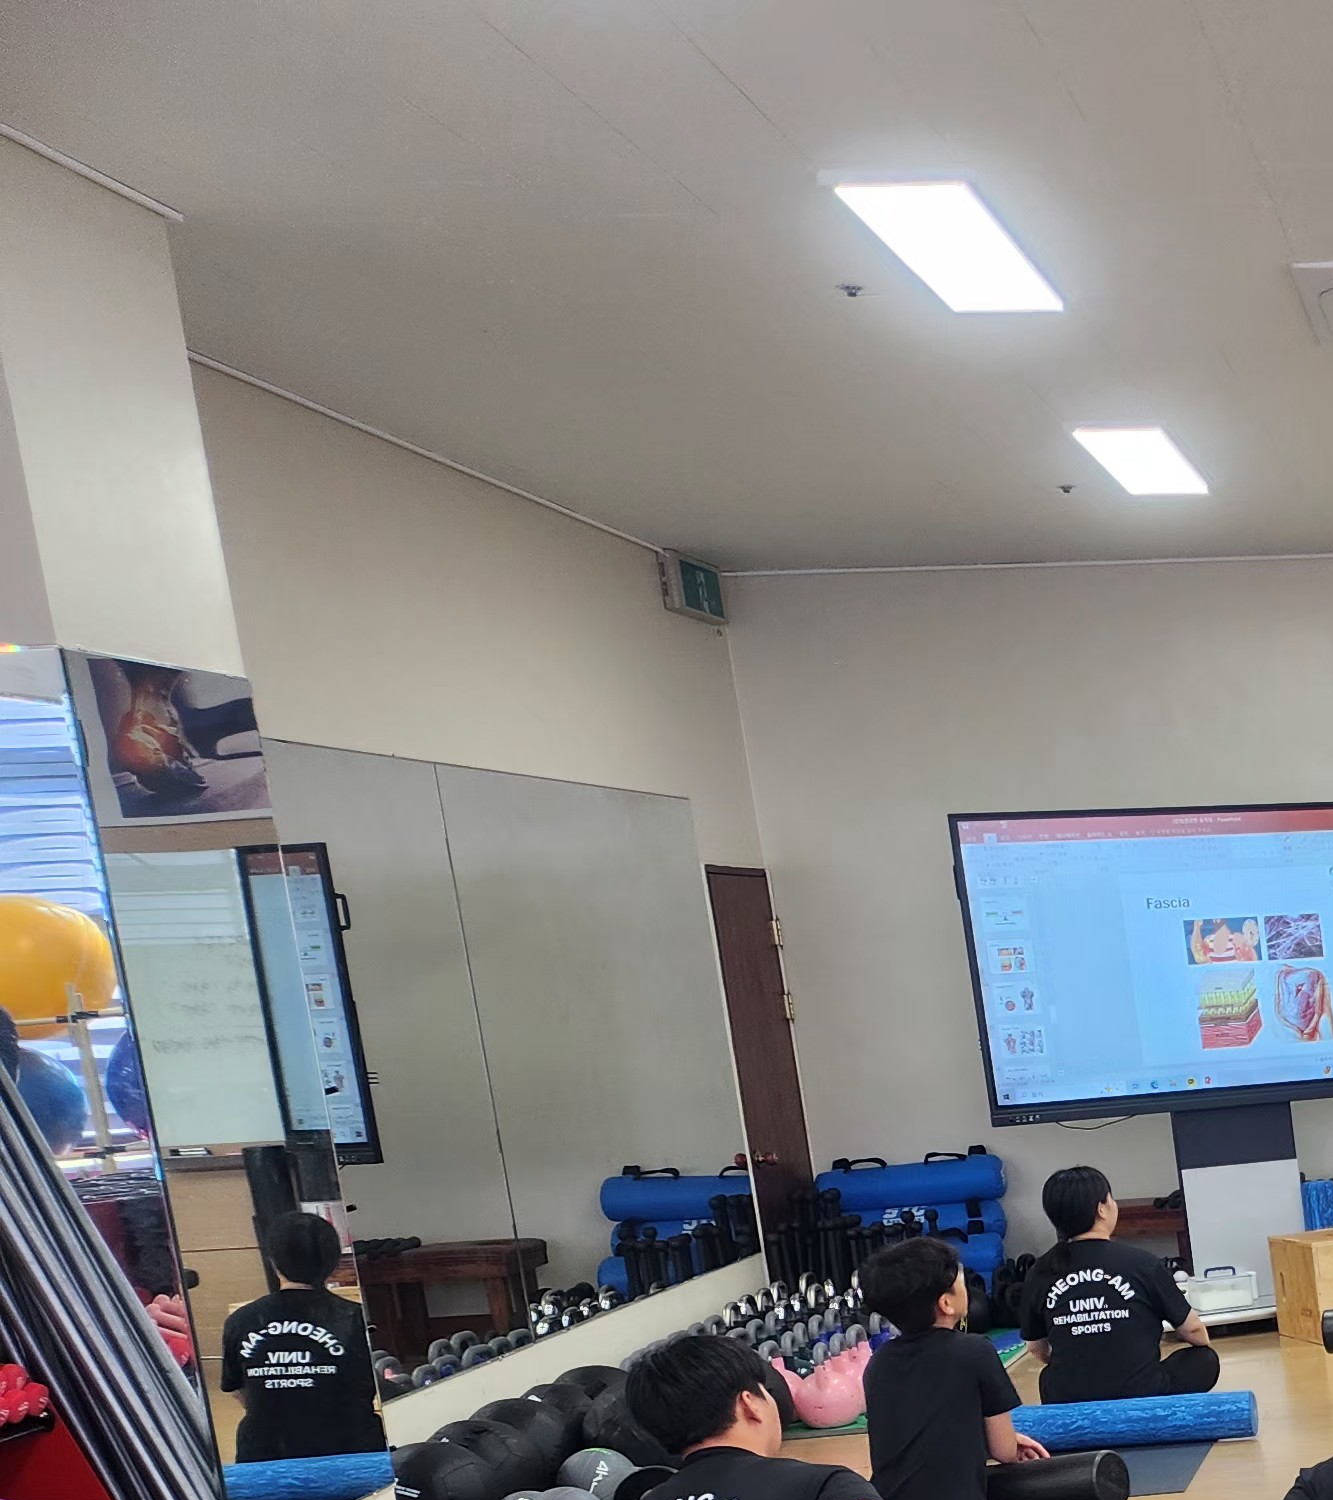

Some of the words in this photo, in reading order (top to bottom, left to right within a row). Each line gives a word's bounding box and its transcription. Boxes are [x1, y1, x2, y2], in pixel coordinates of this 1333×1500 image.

[1146, 897, 1190, 909] Fascia
[1046, 1268, 1135, 1309] CHEONG-AM
[1069, 1296, 1108, 1312] UNIV.
[1053, 1310, 1129, 1325] REHABILITATION
[1071, 1323, 1111, 1335] SPORTS
